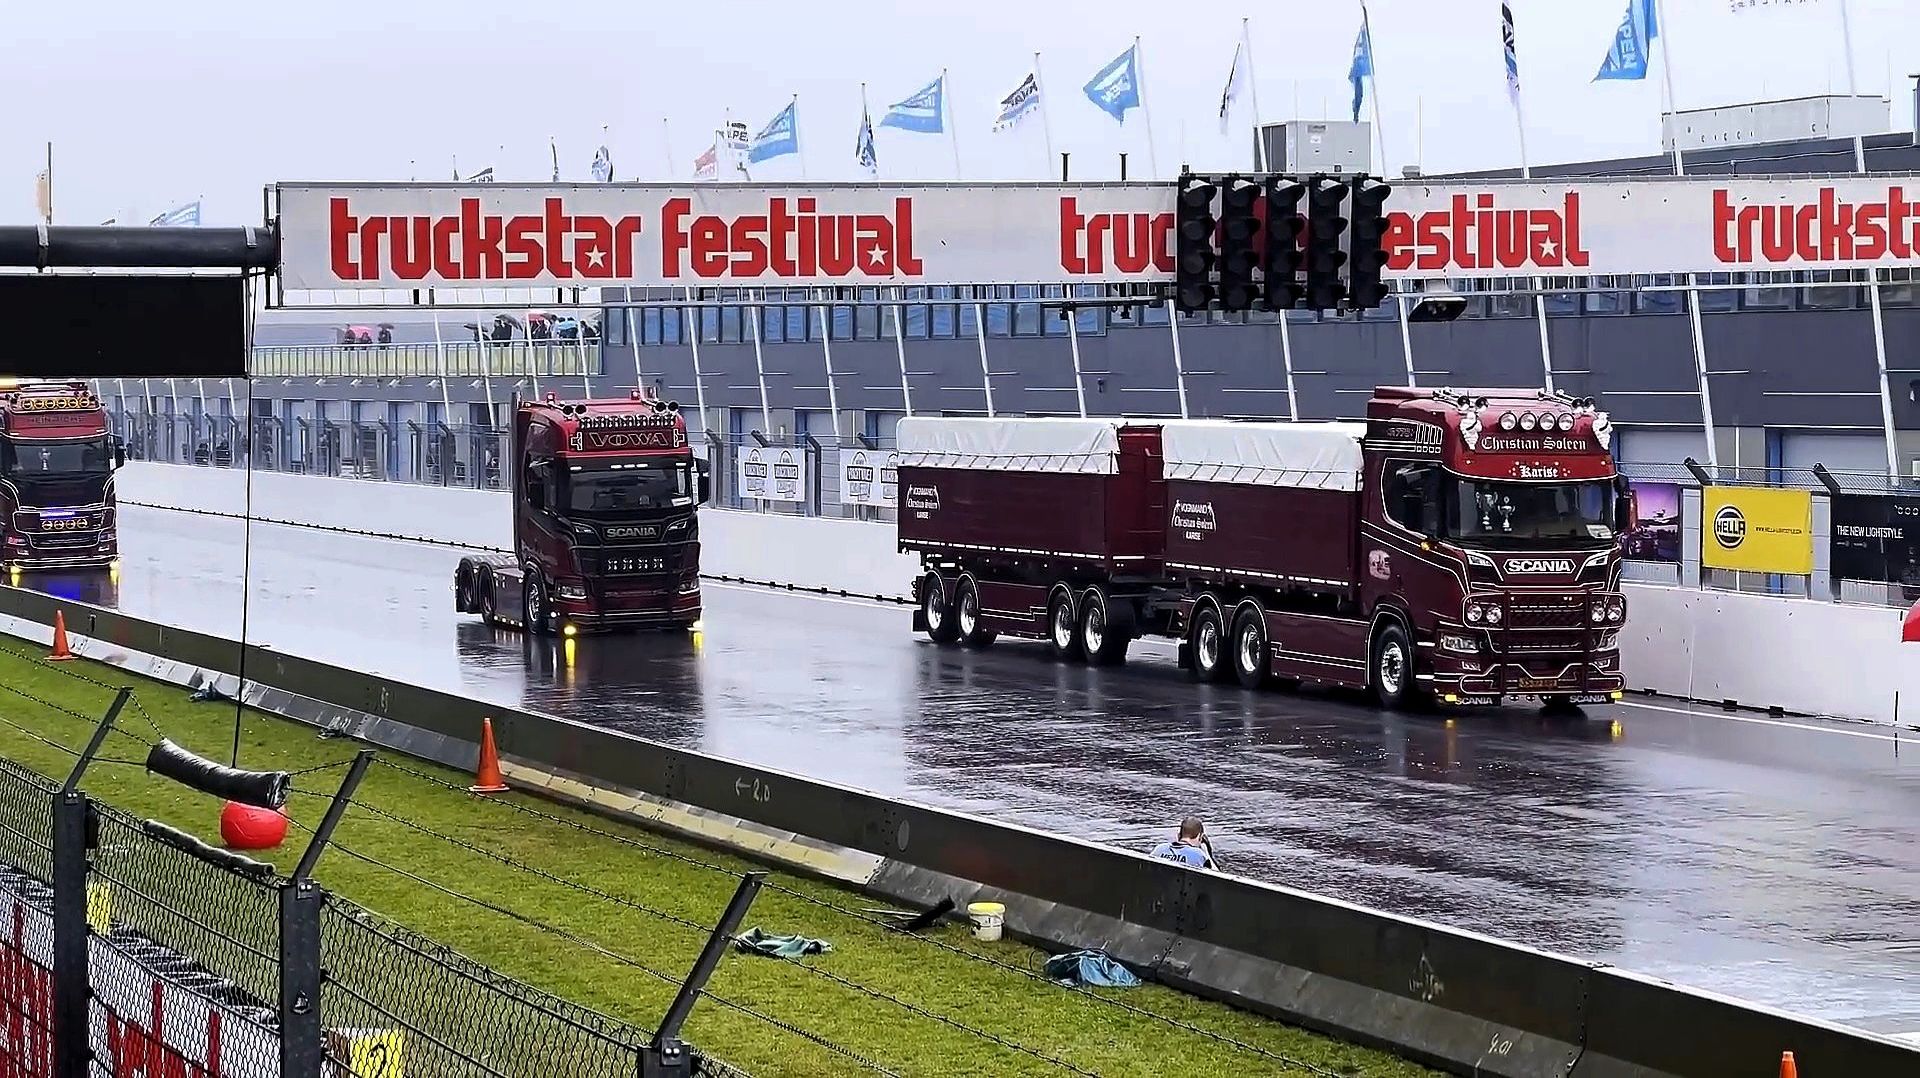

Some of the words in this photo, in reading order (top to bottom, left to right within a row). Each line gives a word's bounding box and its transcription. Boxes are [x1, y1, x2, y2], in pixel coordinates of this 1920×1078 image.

[1712, 186, 1920, 263] truckst
[330, 197, 642, 280] truckstar
[589, 432, 669, 447] VOWA
[1481, 436, 1540, 451] Christian
[1519, 465, 1559, 478] Karise
[606, 527, 657, 538] SCANIA
[1716, 520, 1746, 535] HELLA
[1836, 524, 1850, 536] THE
[1850, 525, 1865, 537] NEW
[1865, 526, 1904, 539] LIGHTSTYLE
[1508, 559, 1572, 573] SCANIA
[1454, 696, 1494, 706] SCANIA
[1569, 694, 1608, 704] SCANIA
